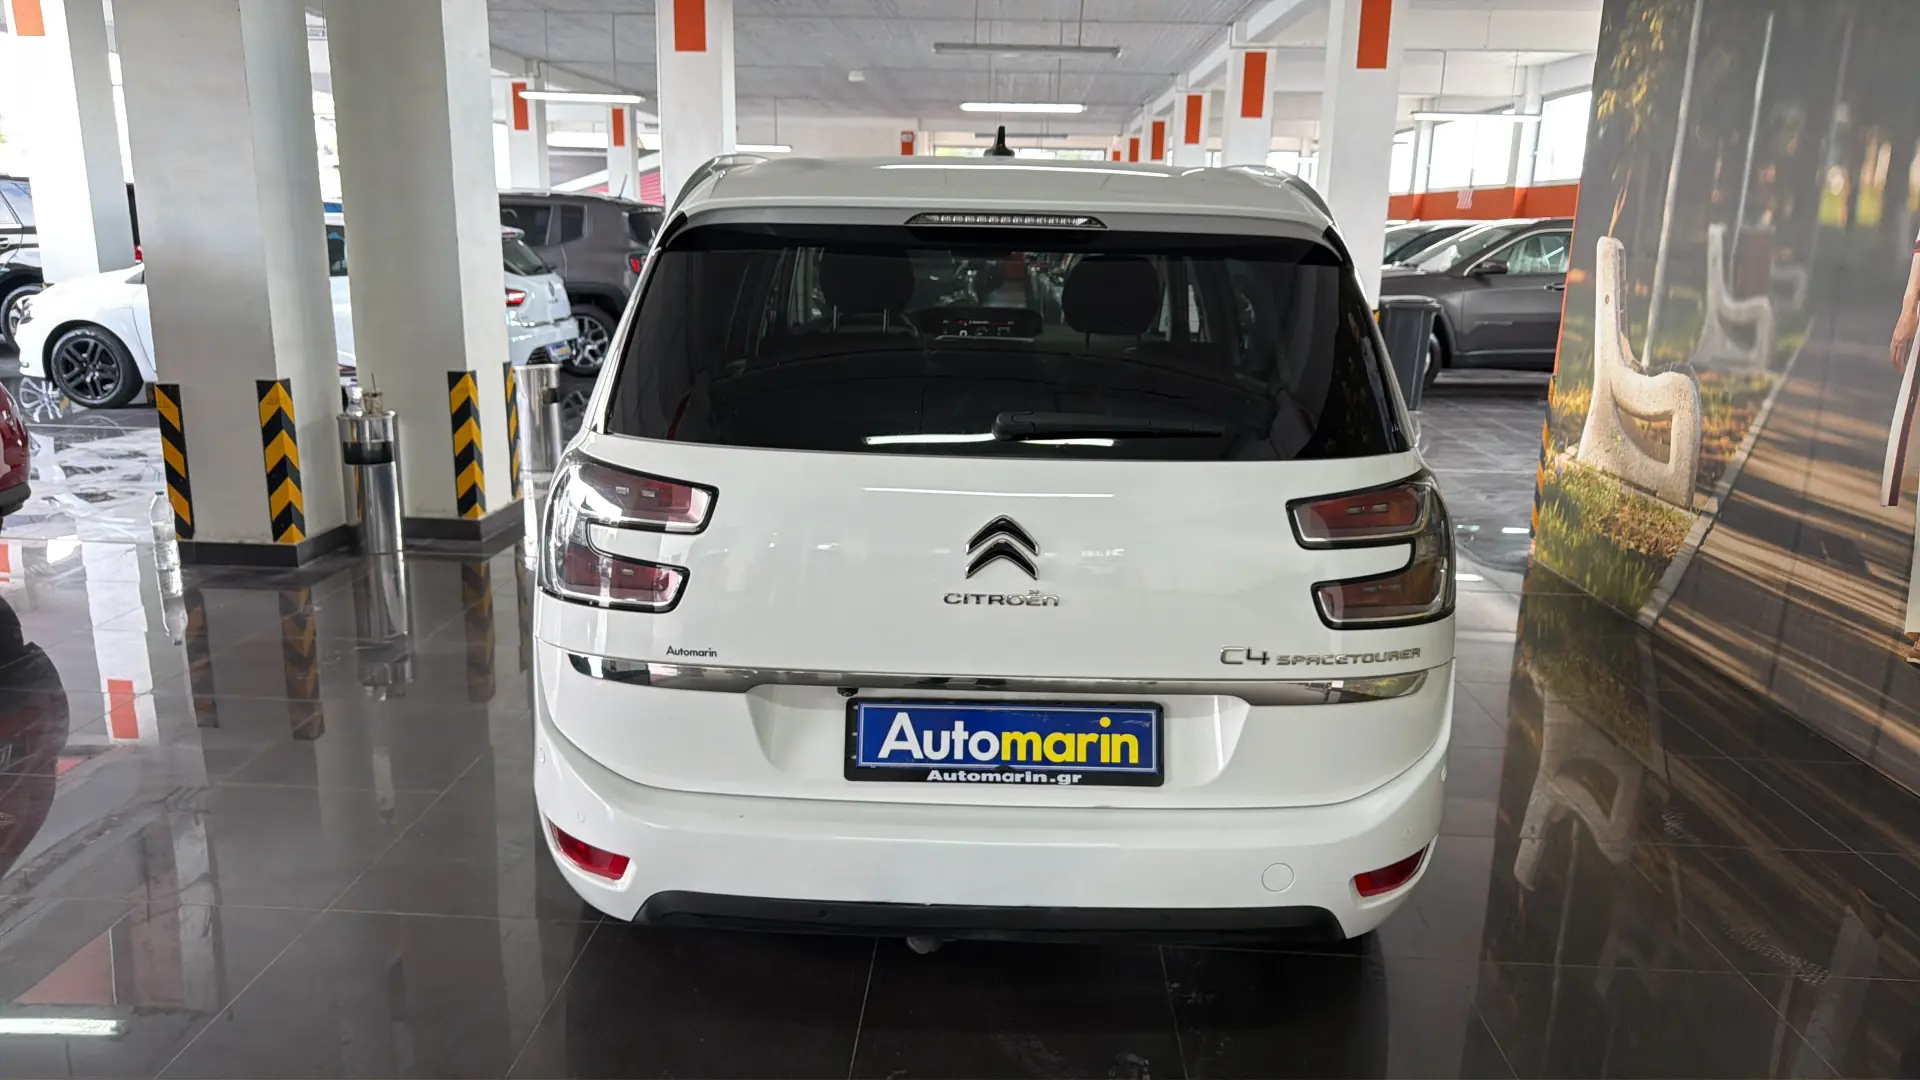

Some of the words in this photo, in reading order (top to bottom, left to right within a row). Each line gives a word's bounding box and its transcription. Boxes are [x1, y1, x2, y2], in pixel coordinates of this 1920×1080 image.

[666, 645, 718, 658] Automarin
[1220, 646, 1270, 666] C4
[1276, 647, 1421, 666] SPACETOURER
[877, 711, 1140, 764] Automarin
[926, 769, 1083, 785] Automarin.gr
